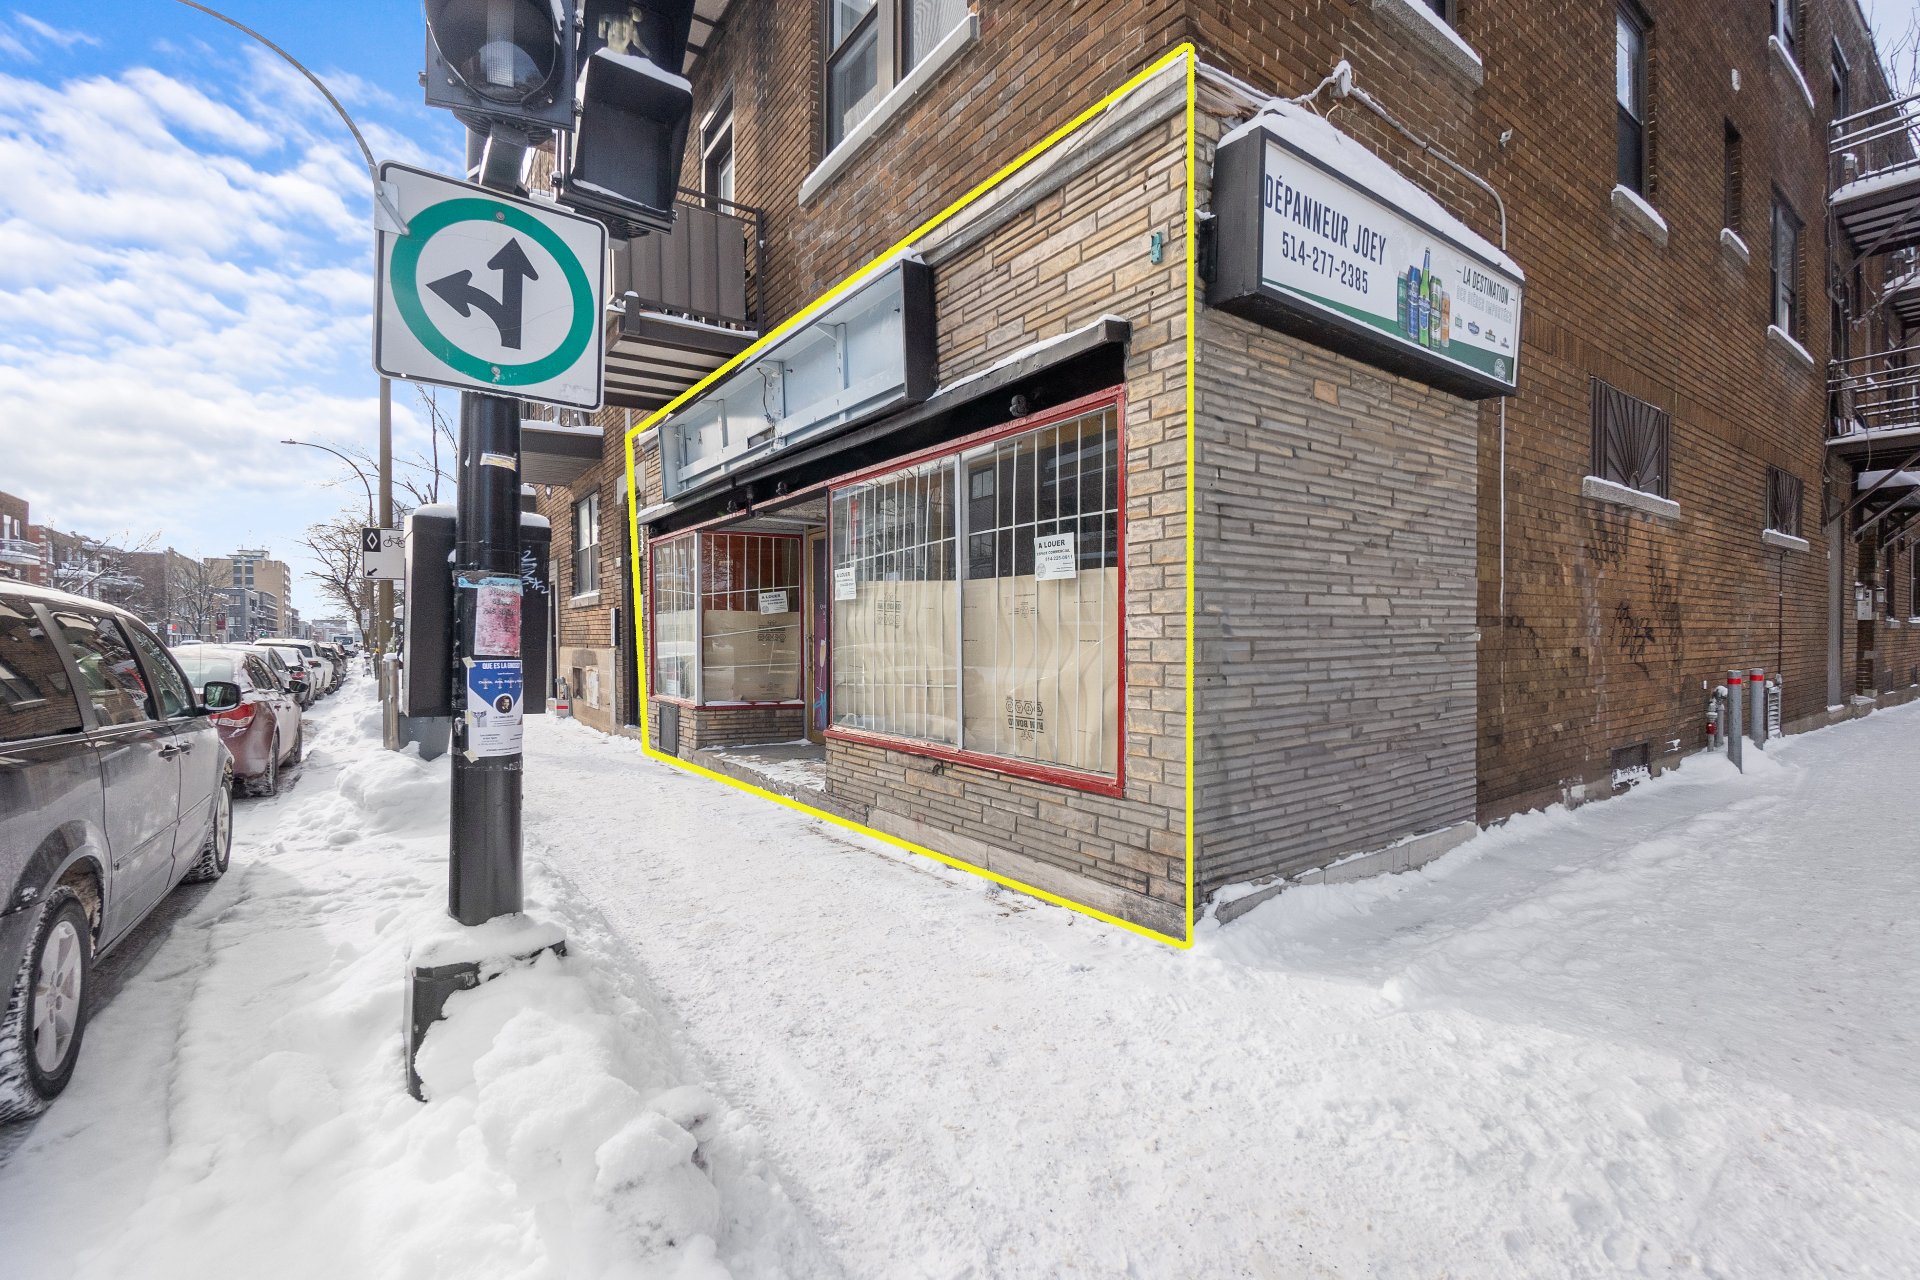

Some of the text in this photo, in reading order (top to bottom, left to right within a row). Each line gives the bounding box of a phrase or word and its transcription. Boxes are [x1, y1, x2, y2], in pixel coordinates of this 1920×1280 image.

[1264, 173, 1386, 265] DÉPANNEUR JOEY
[1282, 231, 1368, 294] 514-277-2385
[1463, 265, 1509, 305] LA DESTINATION
[1044, 540, 1065, 548] LOUER
